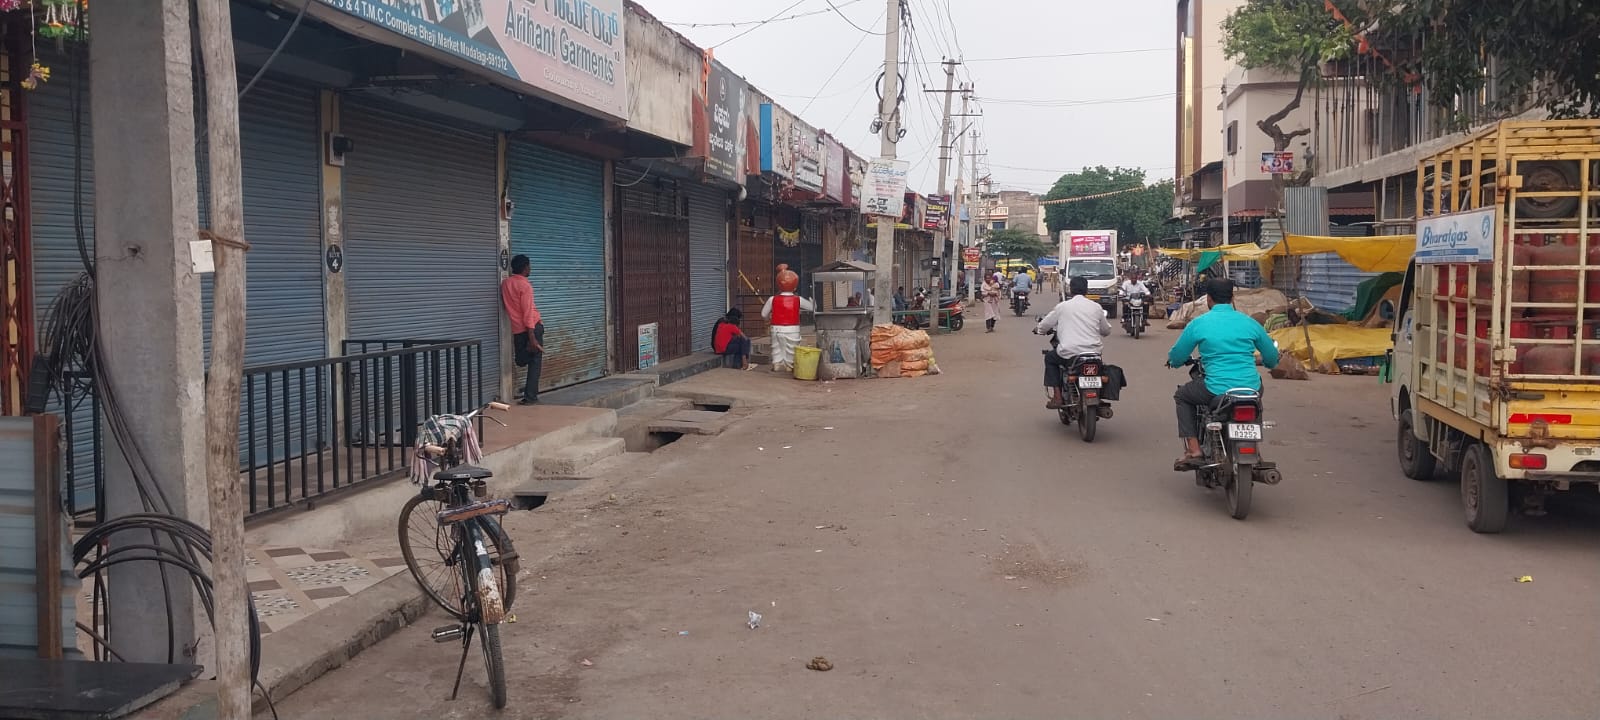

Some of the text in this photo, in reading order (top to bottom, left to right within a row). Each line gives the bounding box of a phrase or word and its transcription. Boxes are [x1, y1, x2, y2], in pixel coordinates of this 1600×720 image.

[346, 0, 352, 11] &
[354, 0, 360, 14] 4
[361, 1, 384, 23] T.M.C
[385, 11, 418, 37] Complex
[419, 24, 438, 47] Bhaji
[437, 32, 460, 53] Market
[504, 0, 614, 82] Arihant Garments
[1422, 226, 1468, 248] Bharatgas
[332, 258, 339, 270] 4
